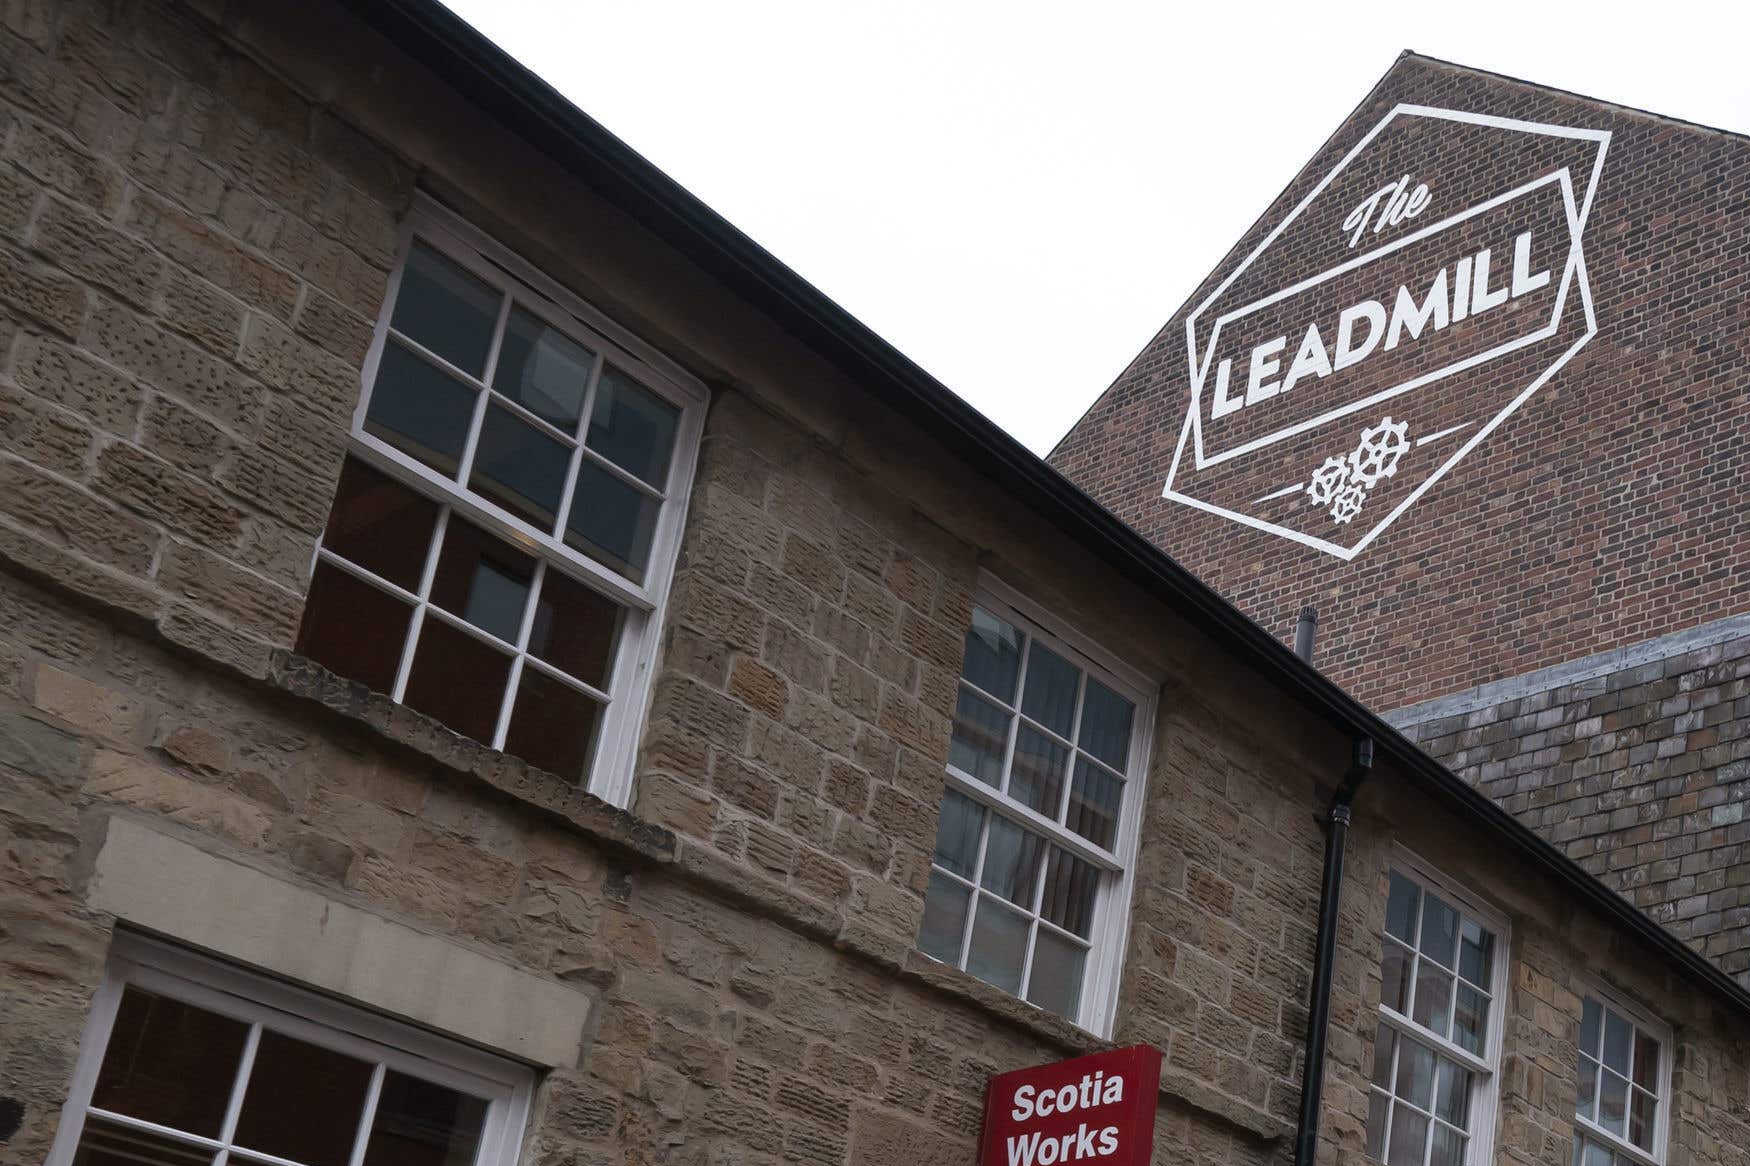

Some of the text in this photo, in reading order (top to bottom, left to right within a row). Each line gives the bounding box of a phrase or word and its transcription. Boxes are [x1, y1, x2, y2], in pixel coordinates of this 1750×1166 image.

[1342, 175, 1432, 248] The
[1211, 231, 1550, 421] LEADMILL
[1011, 1071, 1124, 1122] Scotia
